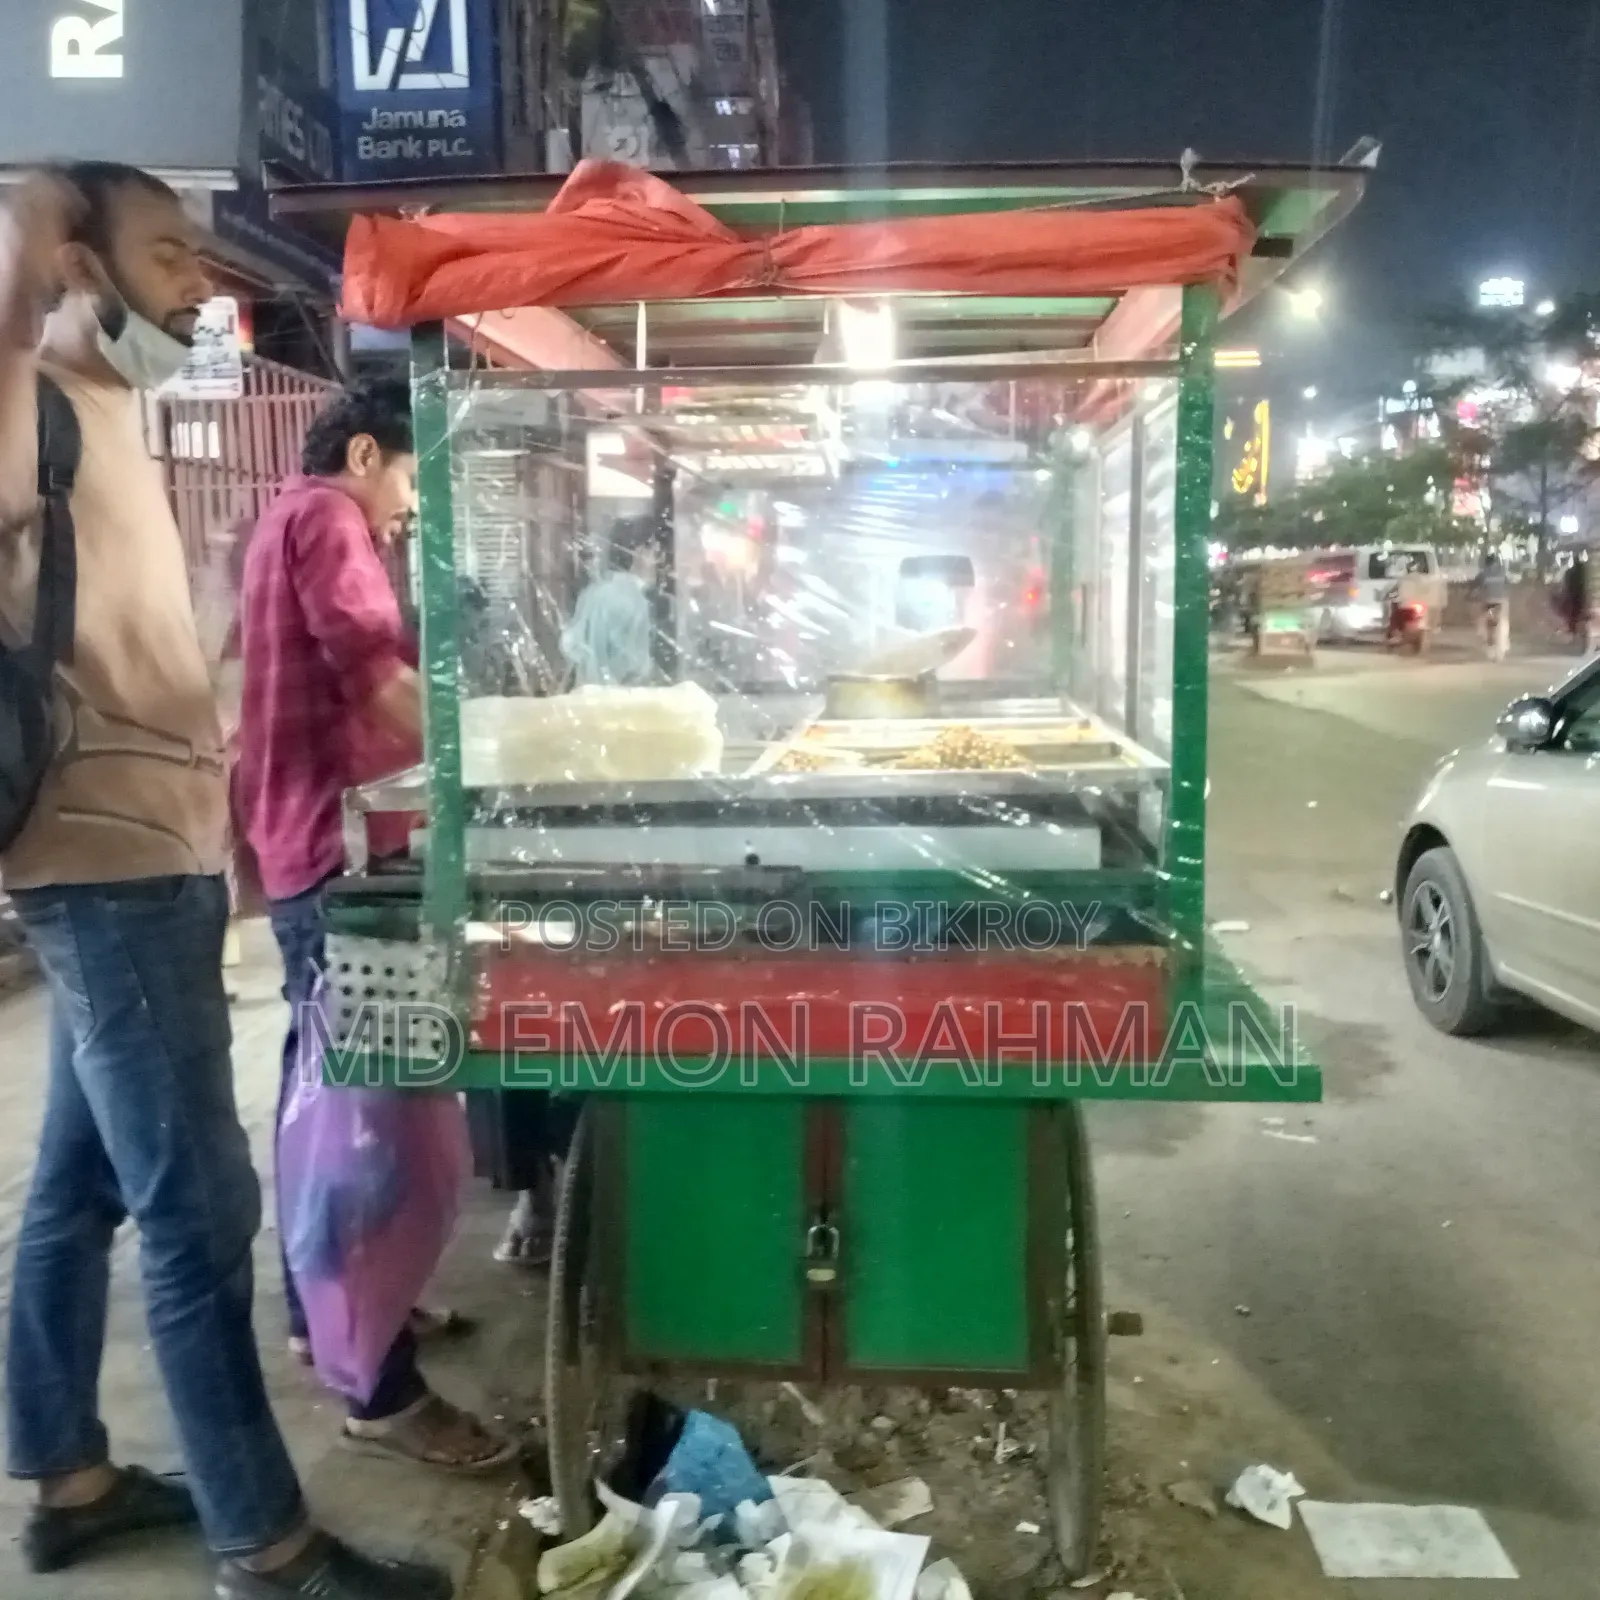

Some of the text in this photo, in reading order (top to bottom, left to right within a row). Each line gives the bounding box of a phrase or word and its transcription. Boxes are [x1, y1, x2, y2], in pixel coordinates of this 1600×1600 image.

[51, 0, 124, 78] R
[361, 106, 468, 131] Jamuna
[357, 135, 424, 160] Bank
